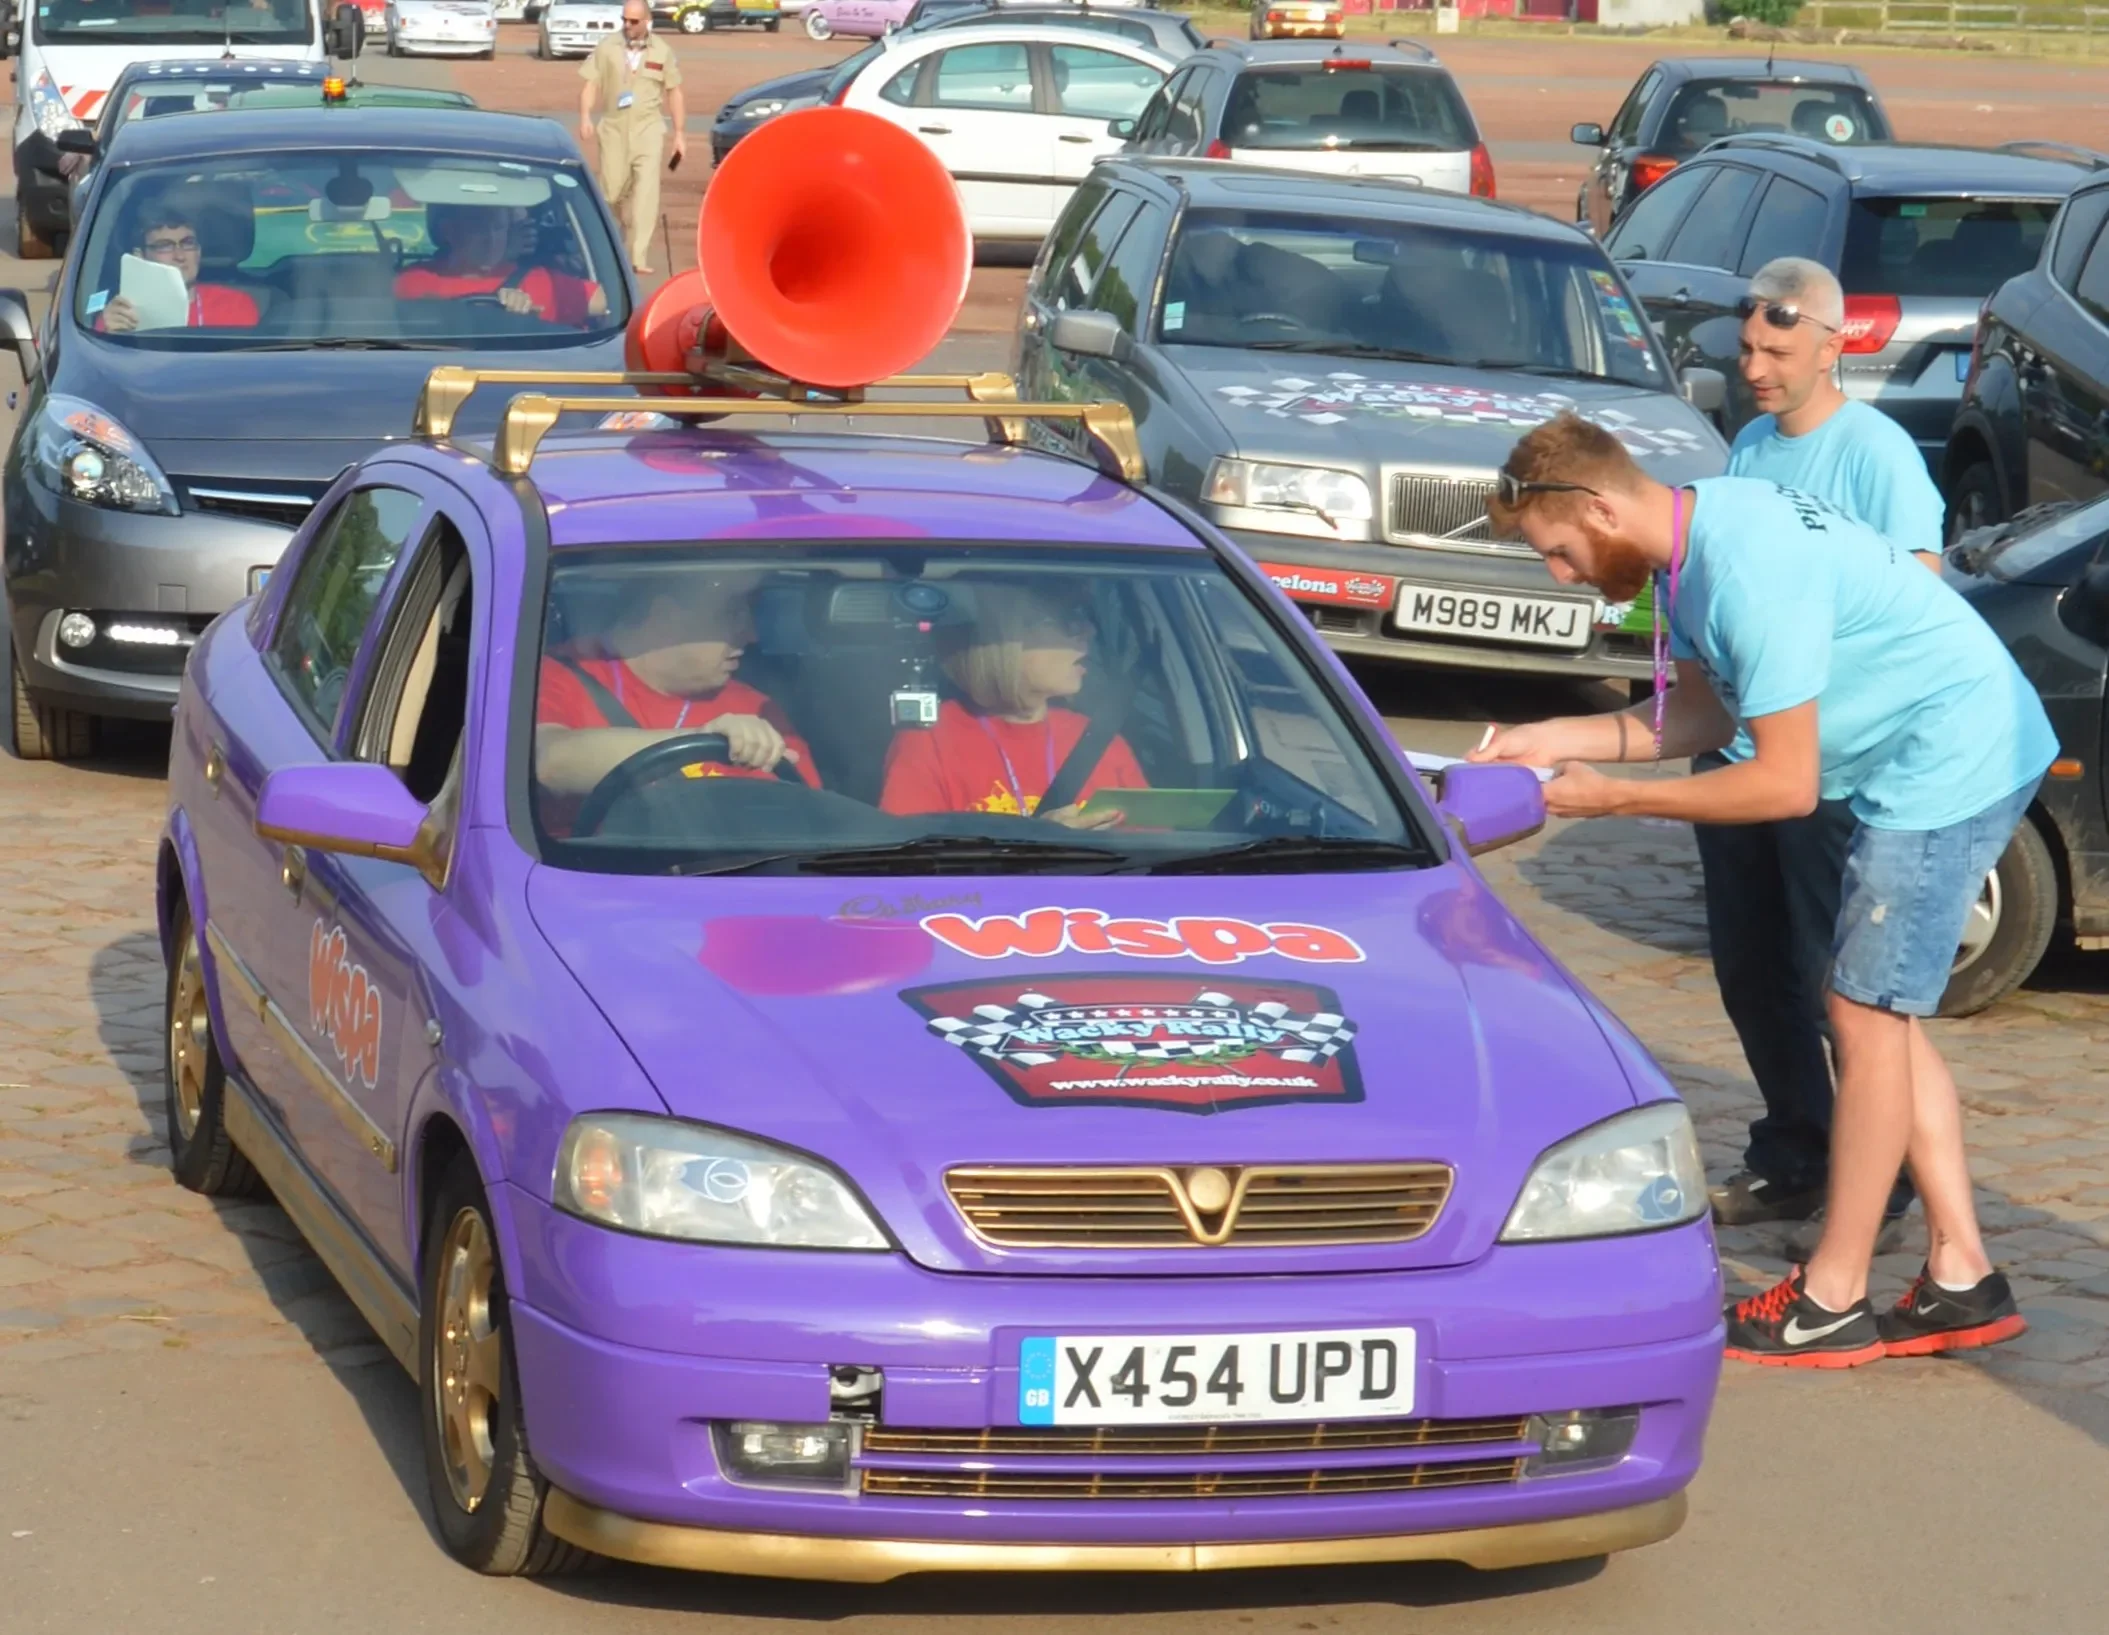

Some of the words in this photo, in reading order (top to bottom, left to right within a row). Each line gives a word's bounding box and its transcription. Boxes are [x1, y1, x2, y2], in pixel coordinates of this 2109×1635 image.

[1270, 574, 1338, 594] celona
[1412, 593, 1501, 630] M989
[1510, 603, 1576, 637] MKJ
[1010, 1020, 1151, 1045] Wacky
[1163, 1019, 1285, 1043] Rally
[1051, 1074, 1318, 1091] www.wackyrally.co.uk
[1063, 1344, 1244, 1409] X454
[1268, 1338, 1398, 1405] UPD
